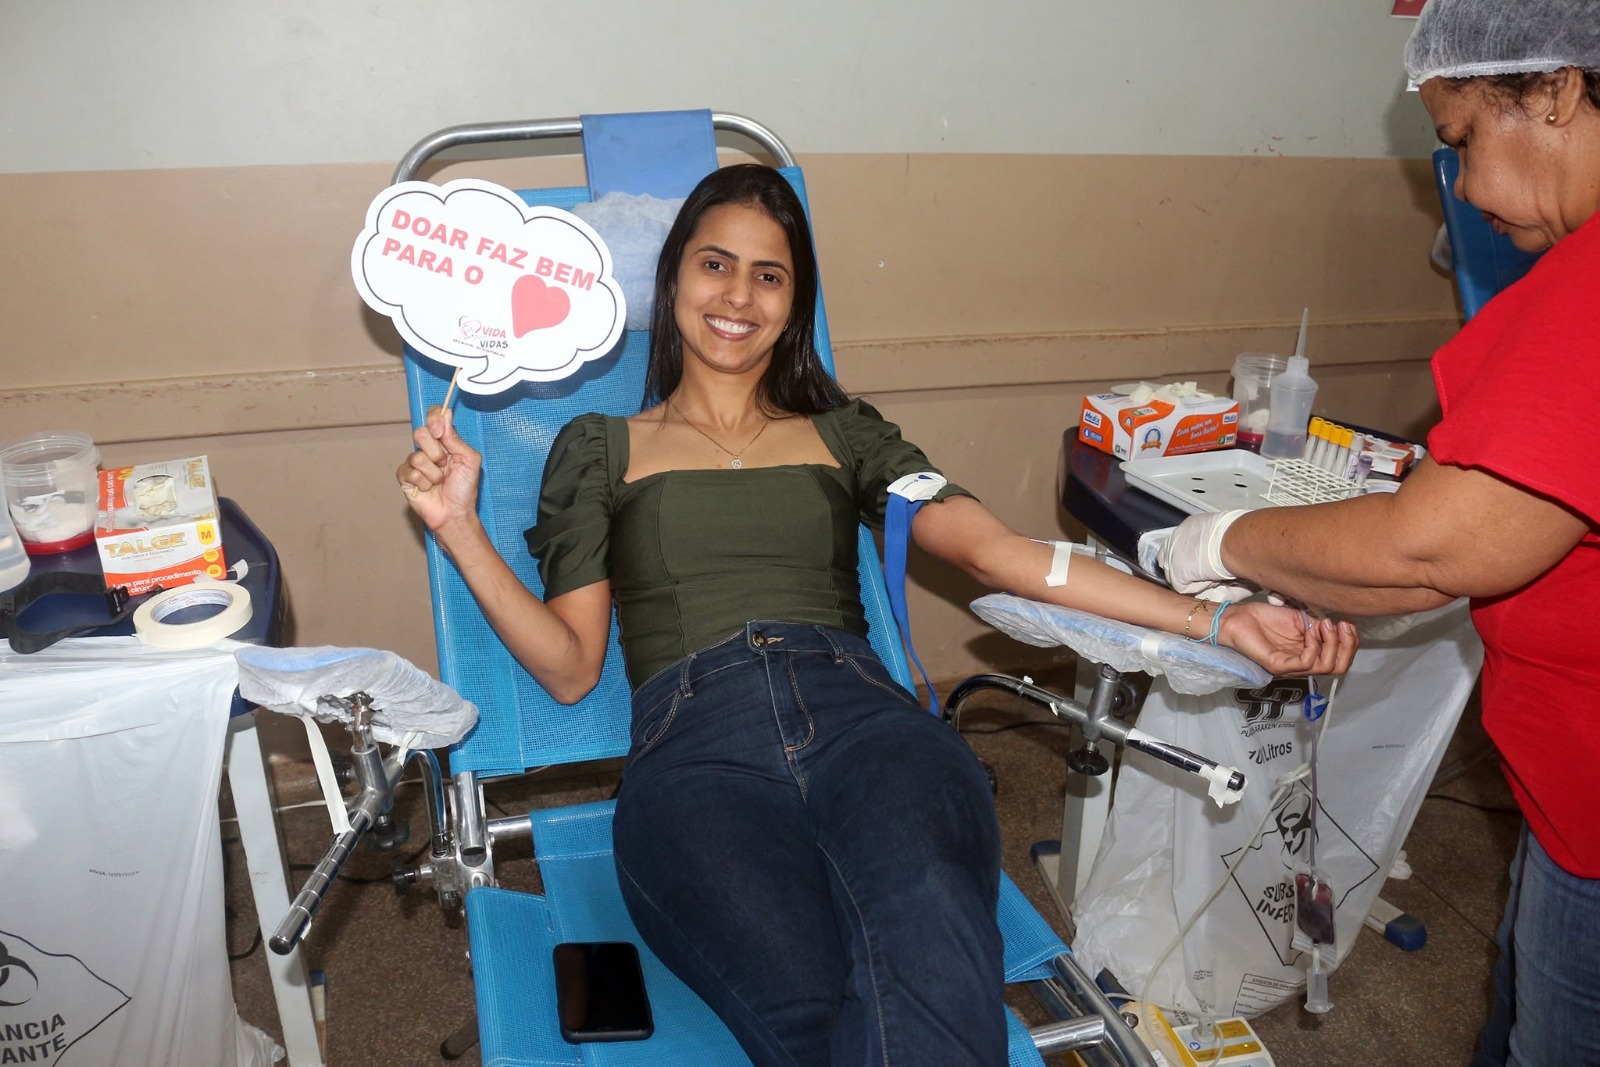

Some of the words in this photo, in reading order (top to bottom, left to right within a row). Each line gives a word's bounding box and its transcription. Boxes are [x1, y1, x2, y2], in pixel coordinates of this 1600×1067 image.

[391, 208, 469, 250] DOAR
[475, 236, 529, 269] FAZ
[534, 255, 596, 292] BEM
[381, 237, 453, 278] PARA
[464, 265, 484, 286] O
[482, 326, 506, 339] VIDA
[480, 340, 508, 349] VIDAS
[1084, 410, 1101, 424] Medix
[103, 531, 187, 558] TALGE
[201, 530, 211, 540] M
[133, 578, 151, 588] para
[151, 569, 201, 585] procedimento
[1263, 741, 1293, 762] Litros
[1263, 882, 1295, 902] SUBS
[1256, 899, 1295, 924] INFEC
